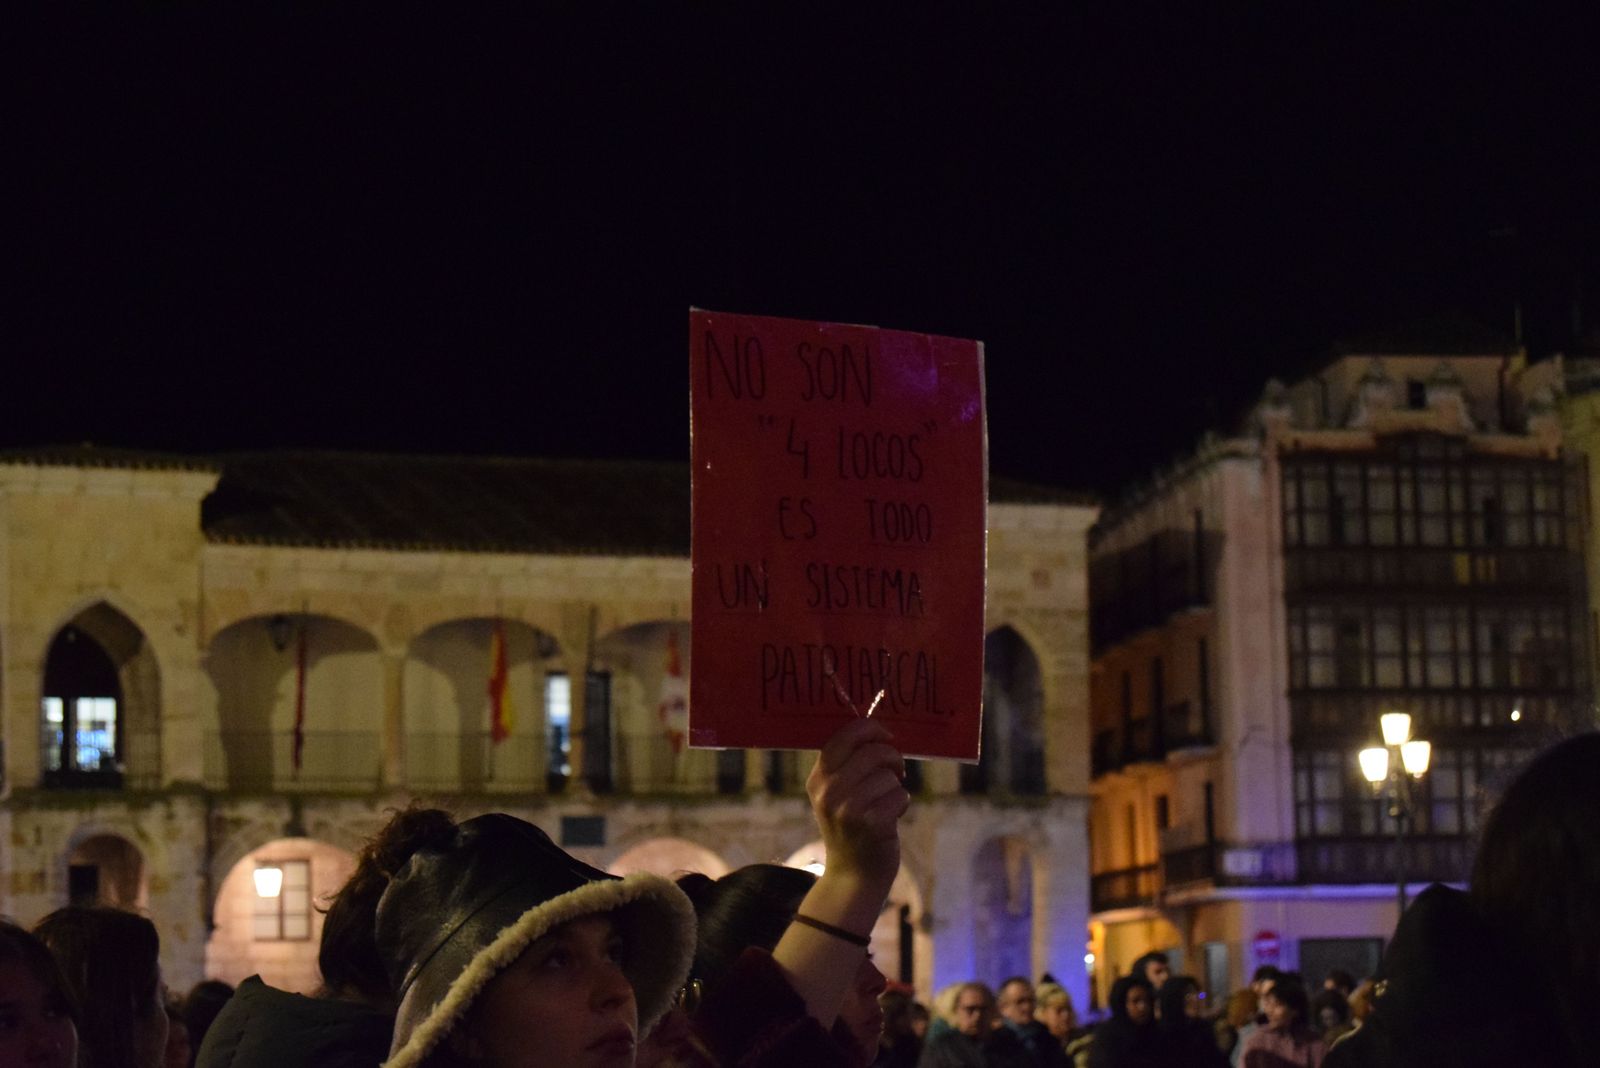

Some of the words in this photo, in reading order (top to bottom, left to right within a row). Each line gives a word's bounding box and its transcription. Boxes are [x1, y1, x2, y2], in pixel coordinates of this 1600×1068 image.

[704, 329, 766, 401] NO
[796, 341, 874, 408] SON
[778, 496, 818, 541] ES
[863, 498, 932, 543] TODO
[716, 560, 769, 609] UN
[806, 562, 924, 616] SISTEMA
